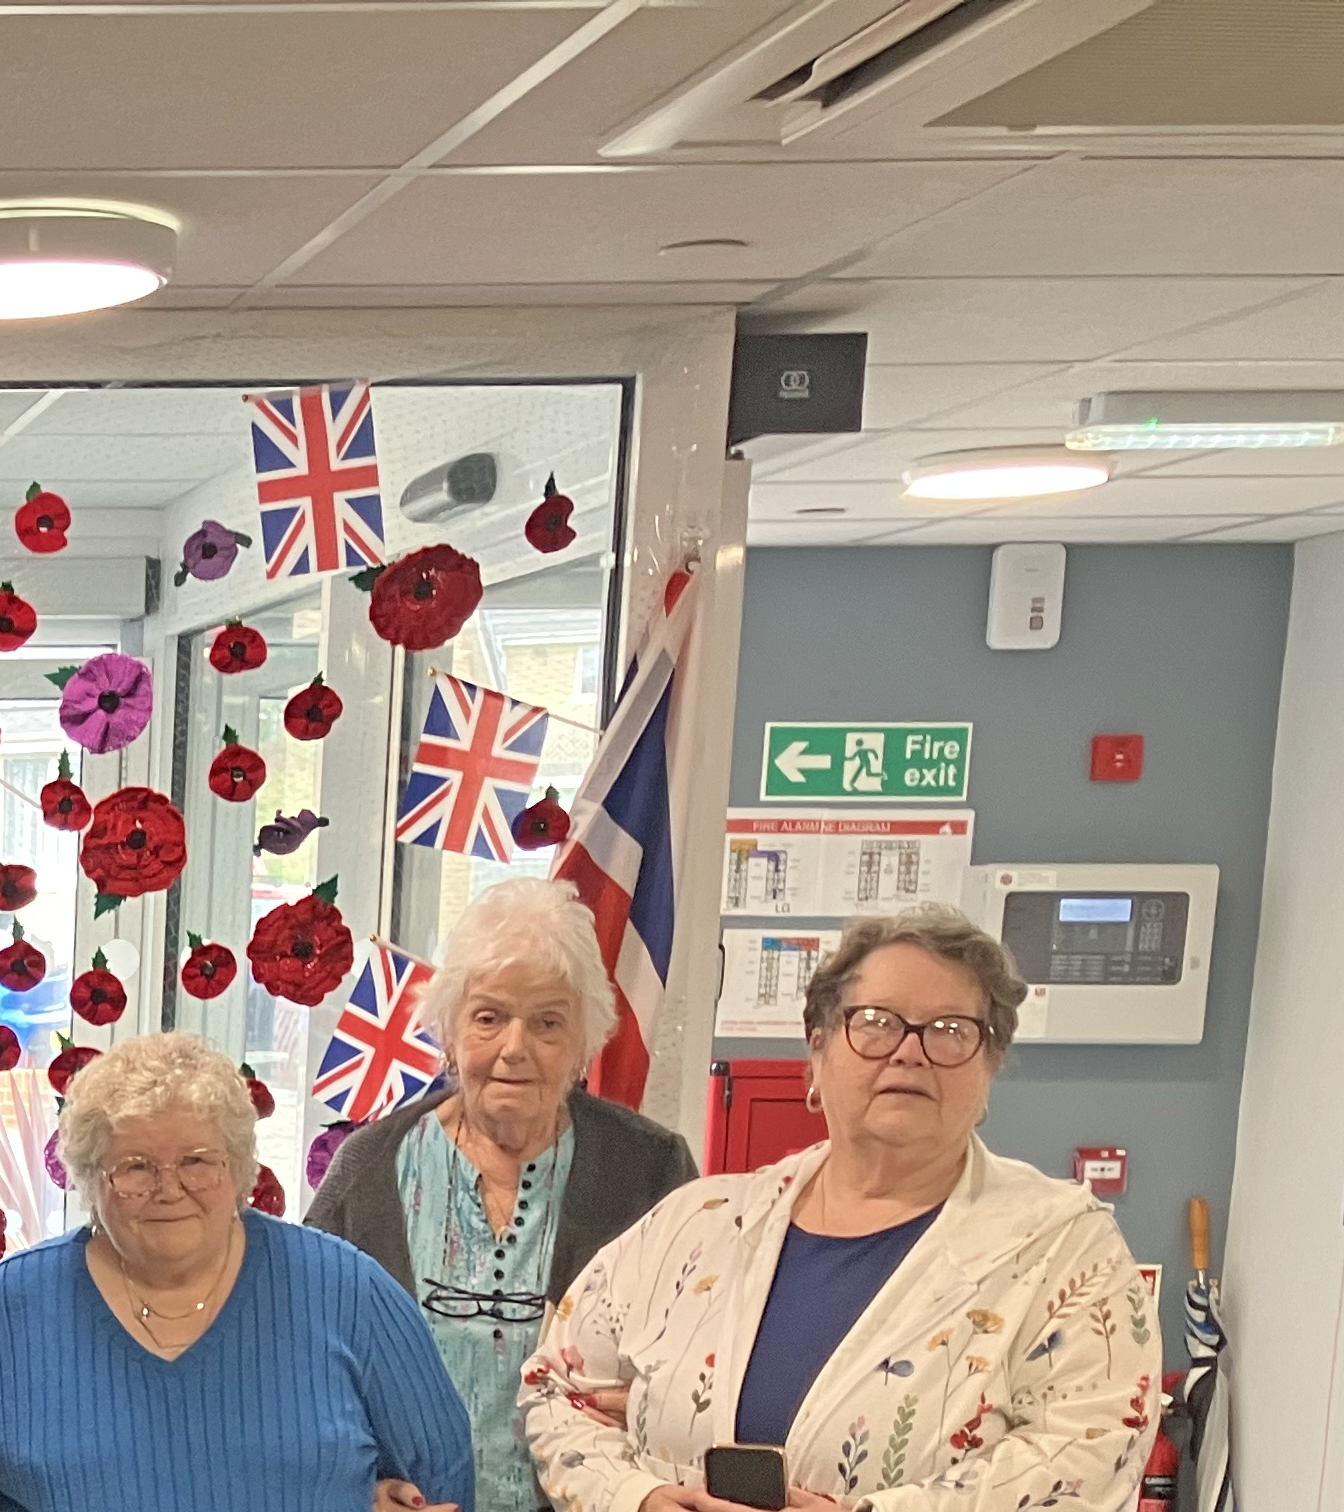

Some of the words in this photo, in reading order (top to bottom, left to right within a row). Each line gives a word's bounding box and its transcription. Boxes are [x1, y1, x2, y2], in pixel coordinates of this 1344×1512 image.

[905, 734, 960, 759] Fire
[904, 762, 957, 787] exit
[780, 821, 820, 832] ALARM
[838, 822, 891, 833] DIAGRAM
